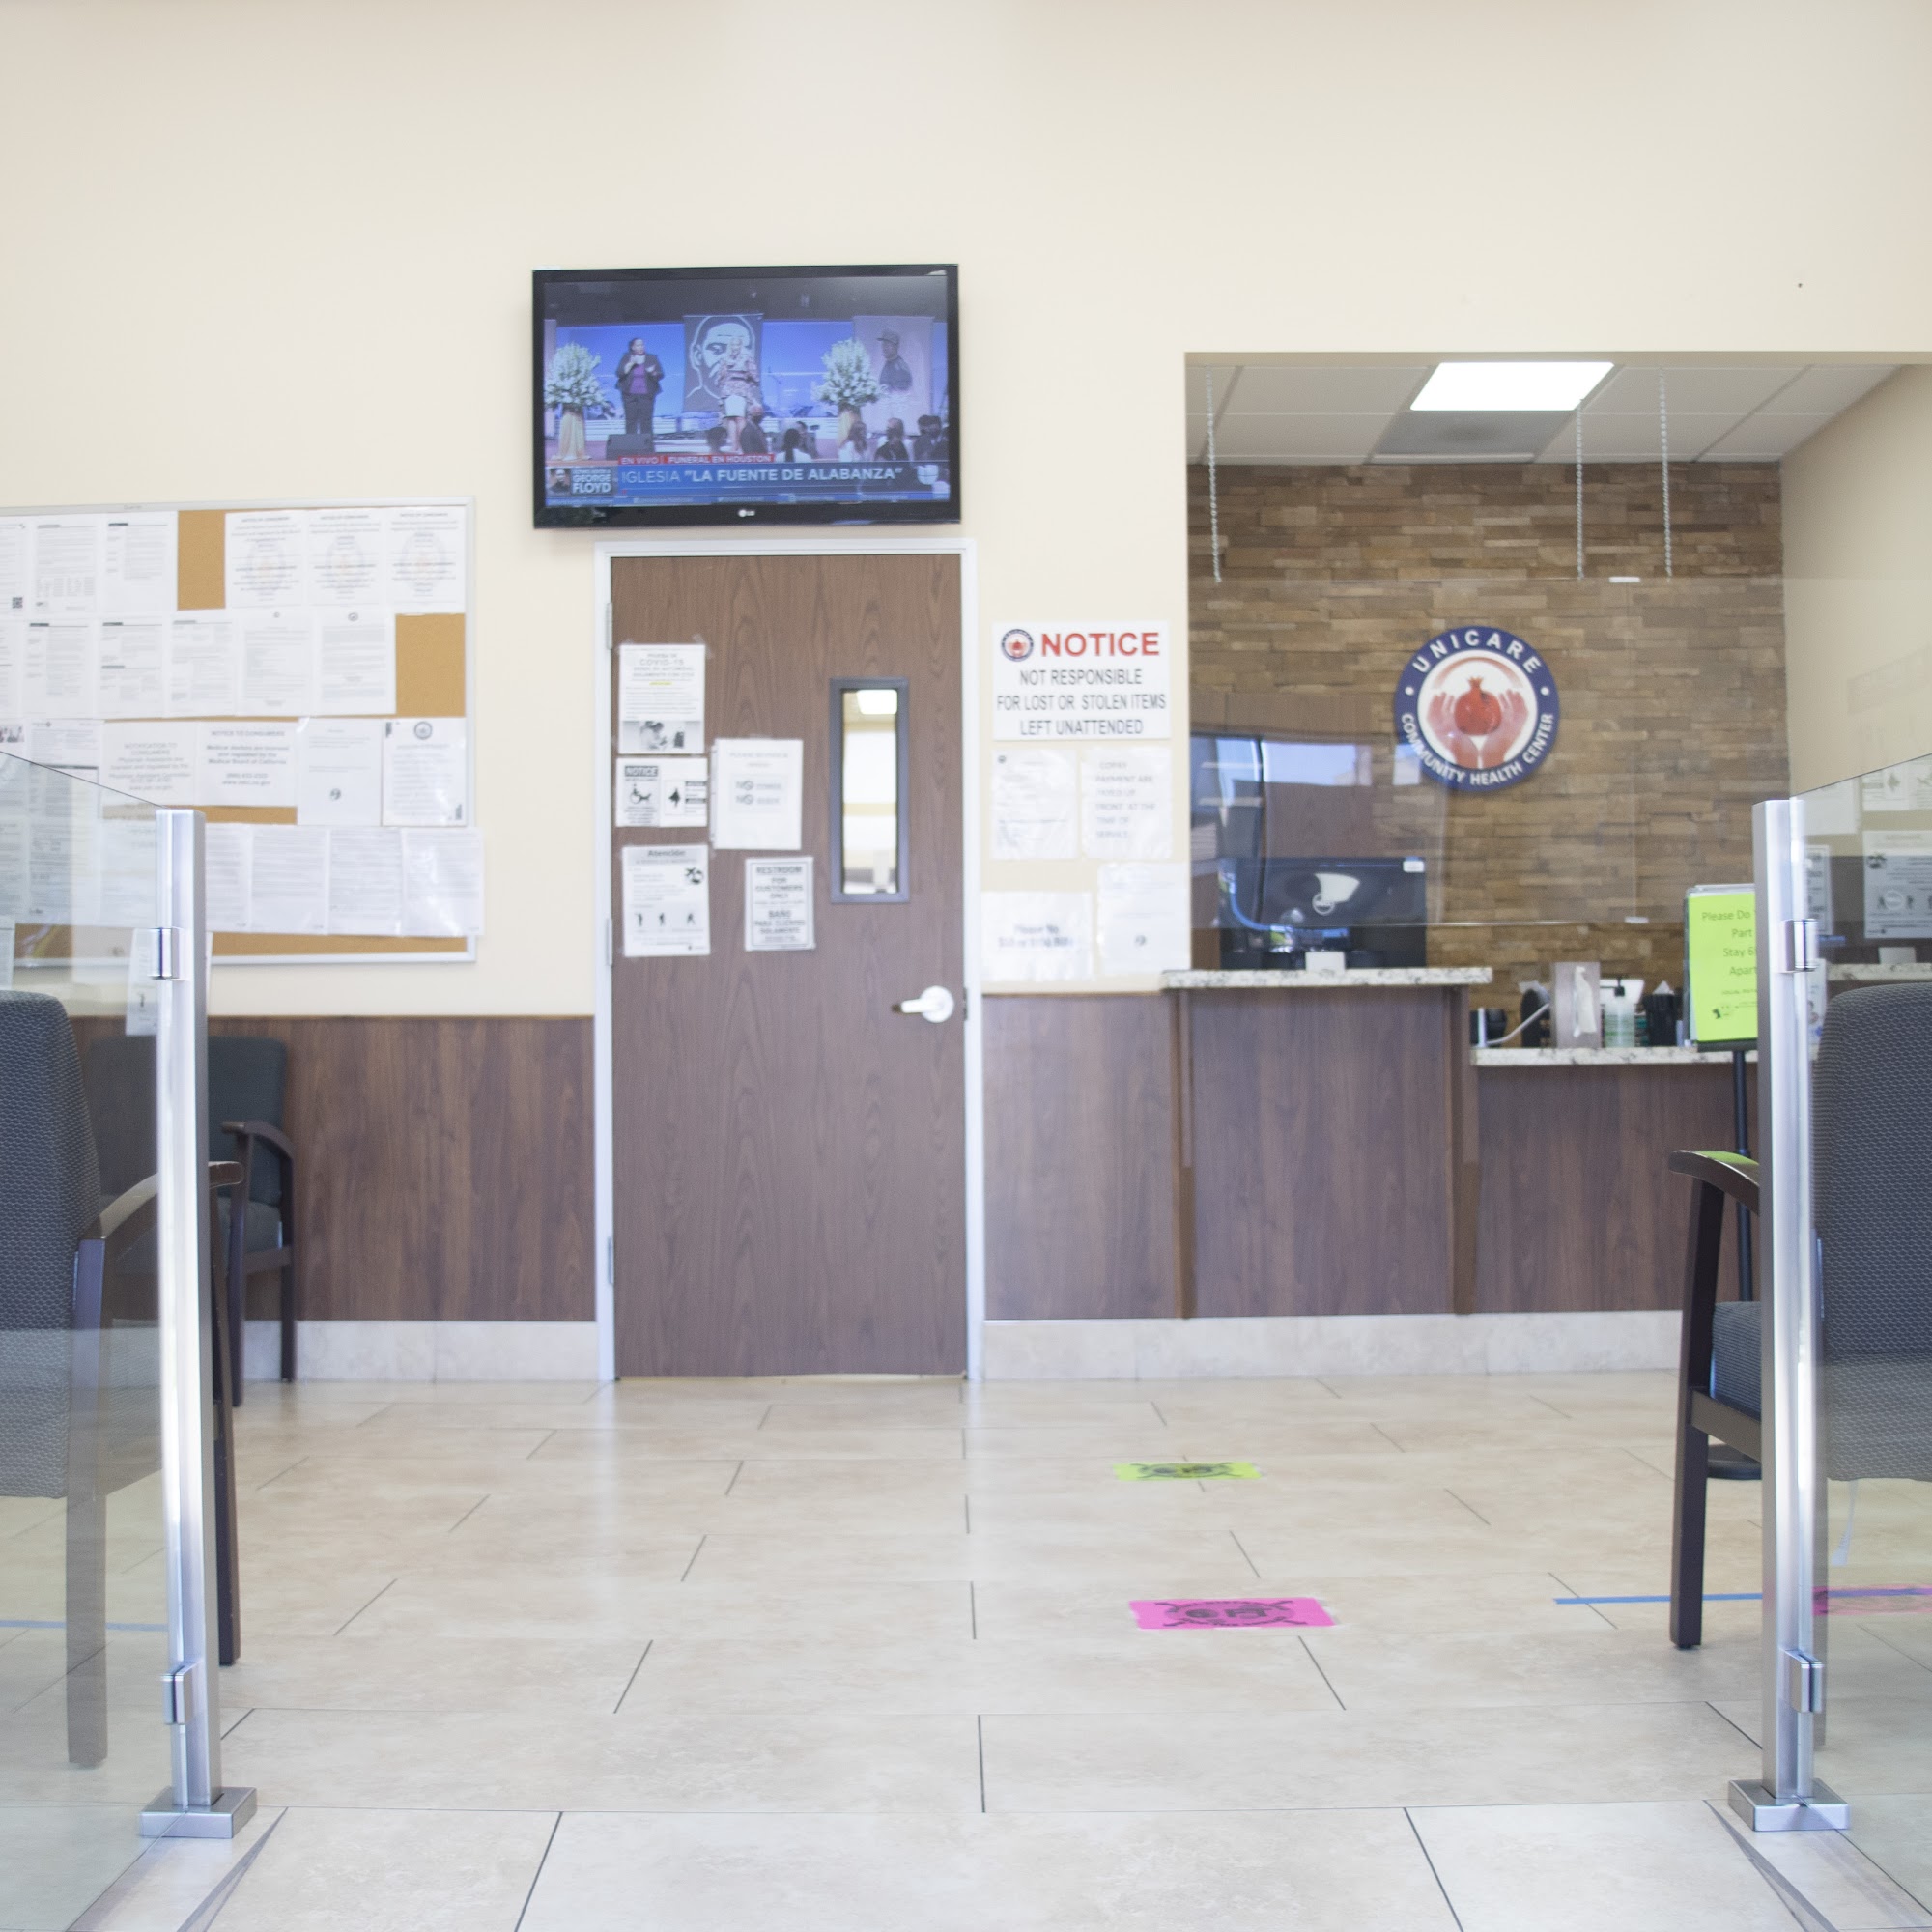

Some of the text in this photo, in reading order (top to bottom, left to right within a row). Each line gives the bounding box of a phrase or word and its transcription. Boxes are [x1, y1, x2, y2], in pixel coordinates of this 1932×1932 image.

[572, 474, 611, 483] GEORGE
[621, 470, 681, 484] IGLESIA
[717, 469, 779, 482] FUENTE
[781, 469, 804, 481] DE
[572, 482, 612, 494] FLOYD
[1041, 632, 1160, 657] NOTICE
[1411, 629, 1543, 674] UNICARE
[1020, 668, 1143, 685] NOT RESPONSIBLE
[997, 693, 1167, 711] FOR LOST OR STOLEN ITEMS
[1020, 719, 1144, 735] LEFT UNATTENDED
[1401, 712, 1554, 786] COMMUNITY HEALTH CENTER
[625, 766, 658, 776] NOTICE
[647, 849, 686, 858] Atención
[756, 866, 802, 874] RESTROOM
[1701, 909, 1751, 921] Please Do
[1731, 928, 1753, 938] Part
[1722, 948, 1746, 958] Stay
[1729, 966, 1757, 977] Apart
